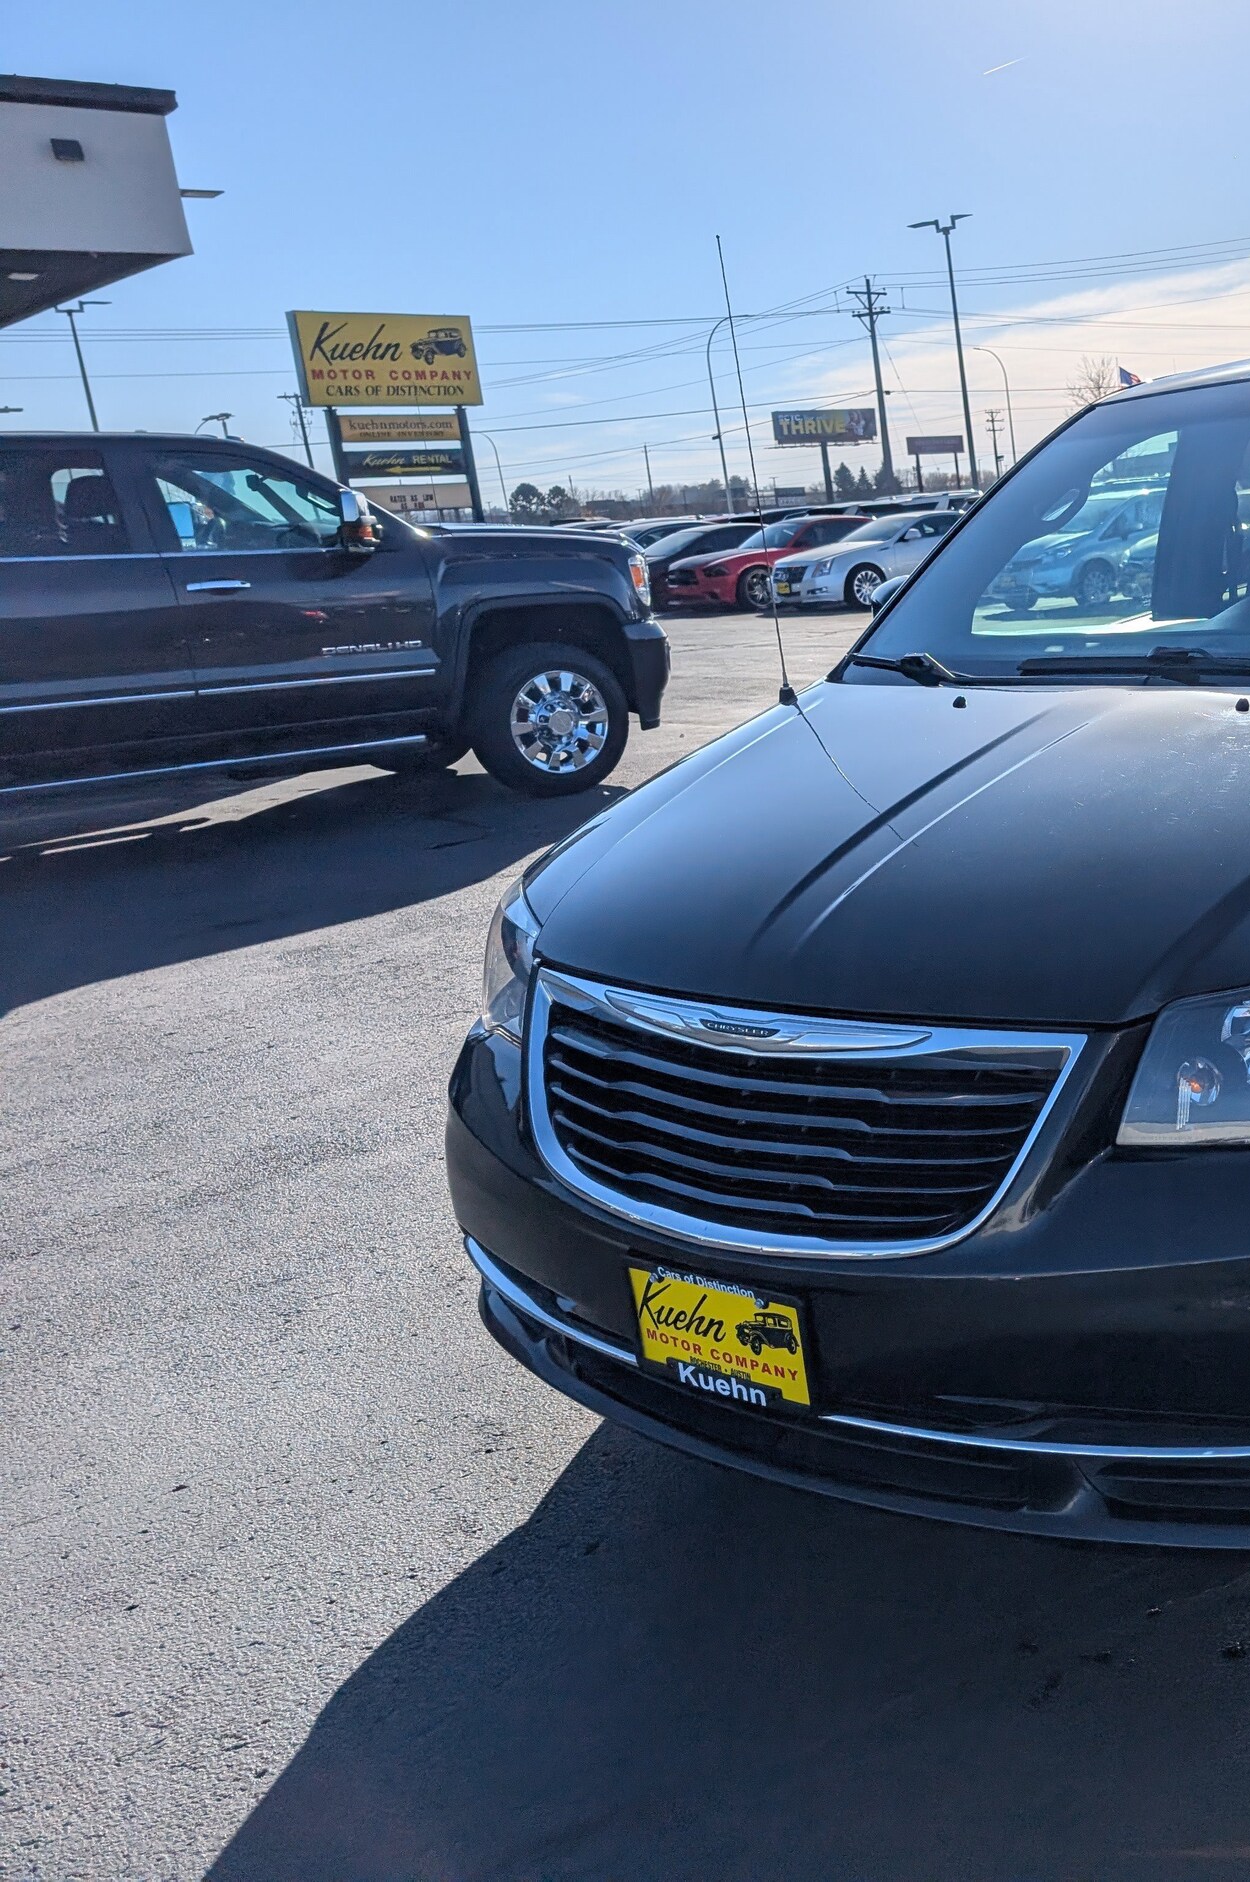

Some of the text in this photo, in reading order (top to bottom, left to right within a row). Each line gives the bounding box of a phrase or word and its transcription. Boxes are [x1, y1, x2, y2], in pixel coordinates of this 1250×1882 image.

[310, 322, 403, 366] Kuehn
[311, 369, 472, 380] MOTOR COMPANY
[326, 384, 464, 397] CARS OF DISTINCTION
[349, 420, 453, 430] kuehnmotors.com
[779, 418, 846, 435] THRIVE
[412, 455, 452, 464] RENTAL
[322, 640, 422, 655] DENALI HD
[706, 1022, 769, 1036] CHRYSLER
[657, 1266, 754, 1299] Cars of Distinction
[638, 1277, 726, 1343] Kuehn
[646, 1327, 799, 1382] MOTOR COMPANY
[690, 1355, 722, 1372] ROCHESTER
[678, 1362, 767, 1407] Kuehn
